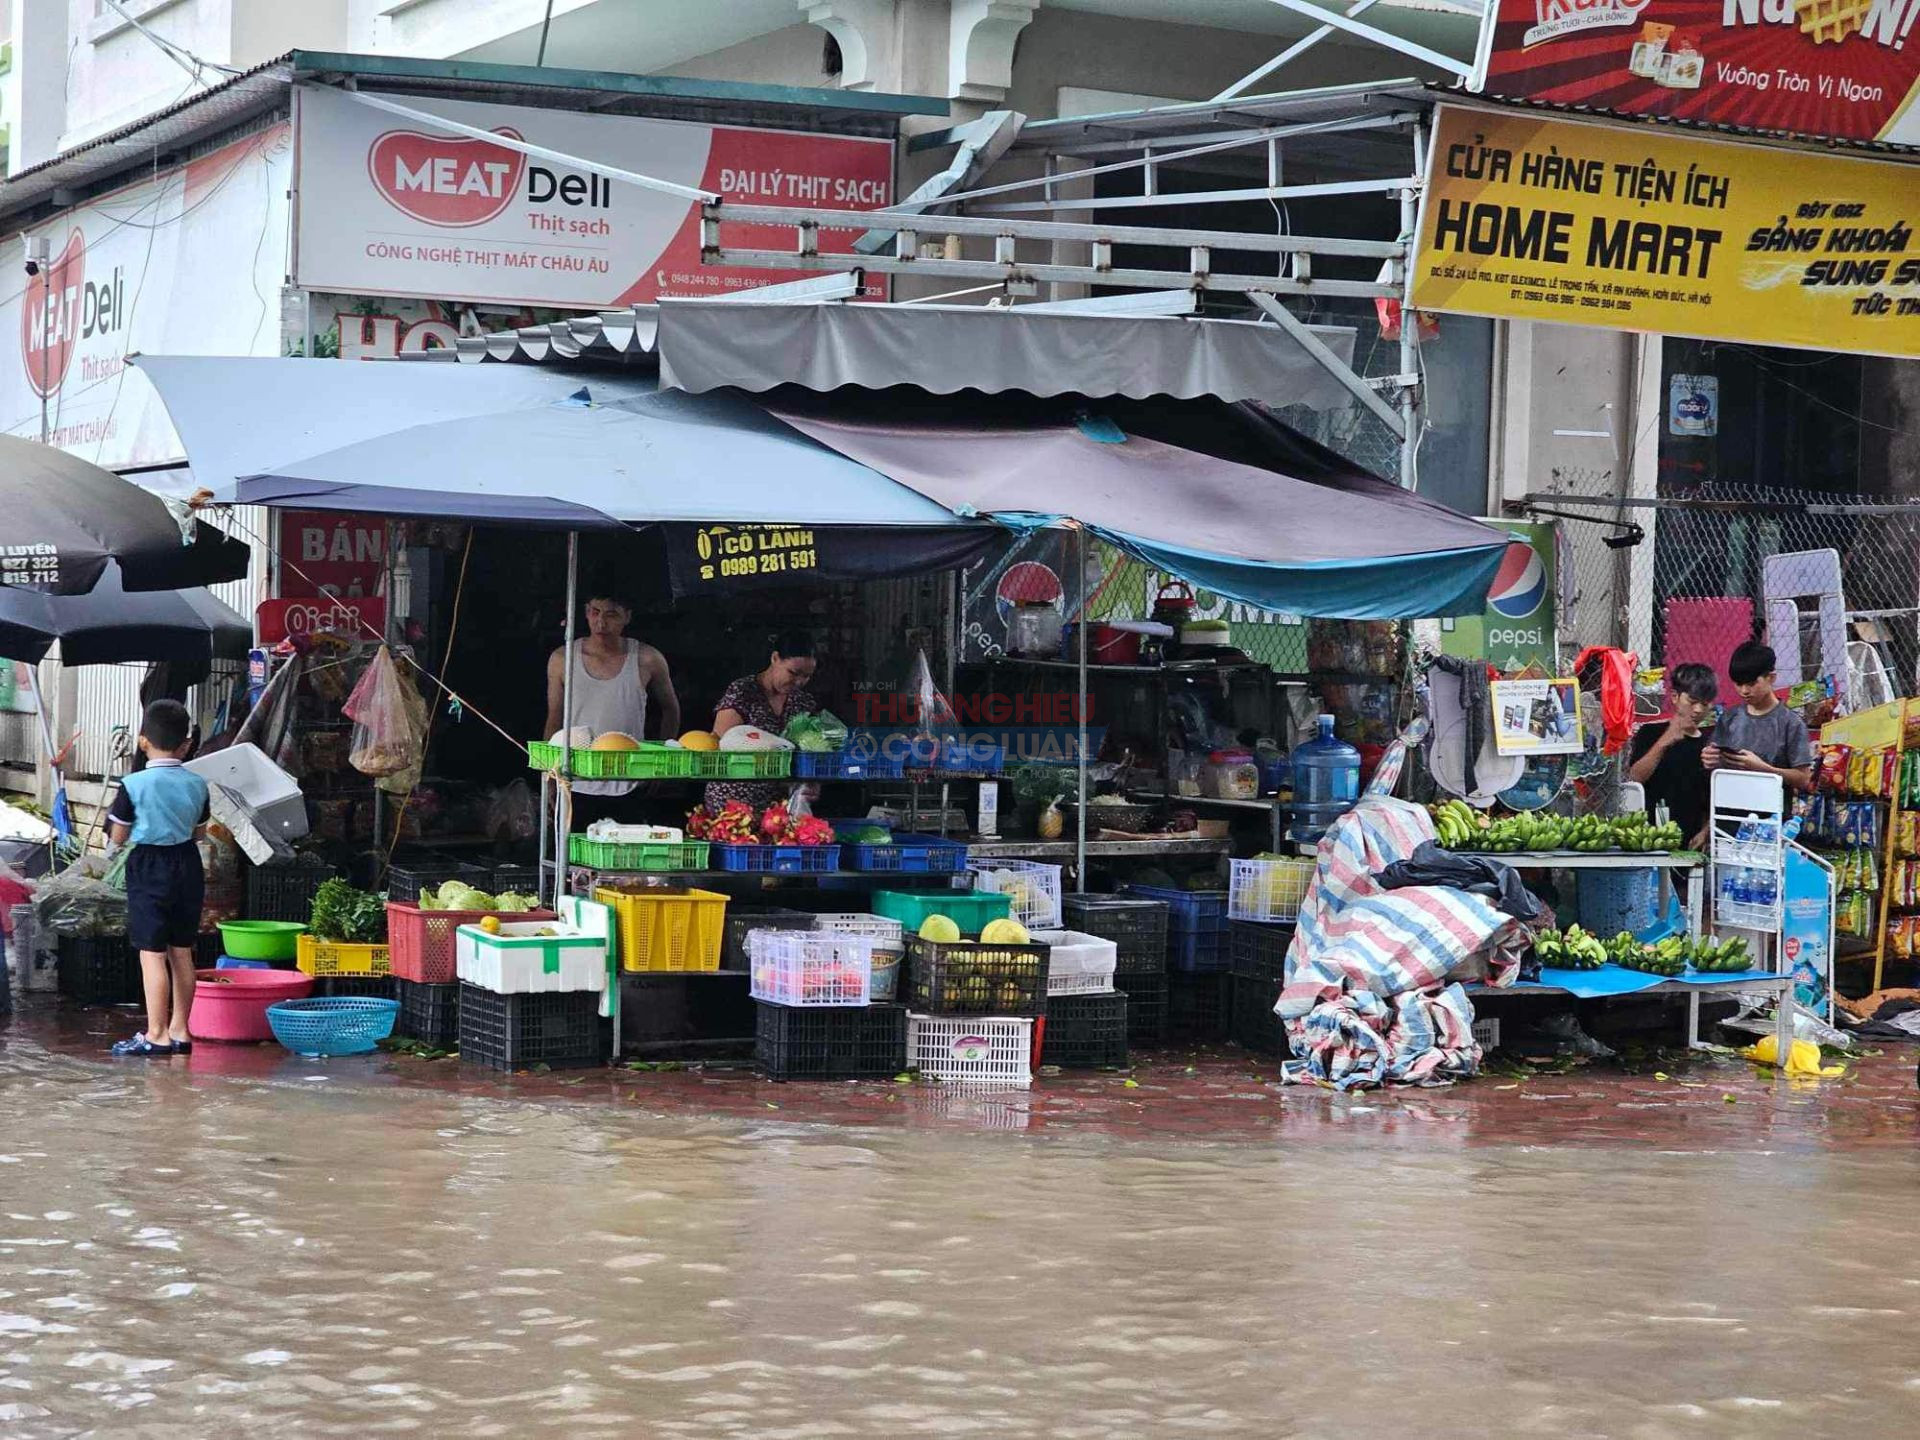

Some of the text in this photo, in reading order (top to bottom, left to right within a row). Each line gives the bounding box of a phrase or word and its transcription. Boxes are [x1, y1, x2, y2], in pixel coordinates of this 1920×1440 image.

[1717, 62, 1883, 101] Vuông Tròn Vị Ngon
[395, 154, 510, 199] MEAT
[1447, 134, 1730, 209] CỬA HÀNG TIỆN ÍCH
[720, 168, 886, 209] ĐẠI LÝ THỊT SẠCH
[528, 213, 610, 238] Thịt sạch
[1831, 203, 1866, 218] GAZ
[1434, 199, 1722, 279] HOME MART
[1745, 215, 1913, 252] SẢNG KHOÁI
[366, 242, 609, 274] CÔNG NGHỆ THỊT MÁT CHÂU ÂU
[1800, 259, 1890, 286] SUNG
[30, 265, 124, 353] MEAT Deli
[302, 521, 382, 562] BÁN
[725, 533, 753, 554] CÔ
[32, 556, 59, 569] 322
[33, 570, 59, 583] 712
[721, 549, 816, 577] 0989 281 591
[1489, 626, 1543, 648] pepsi
